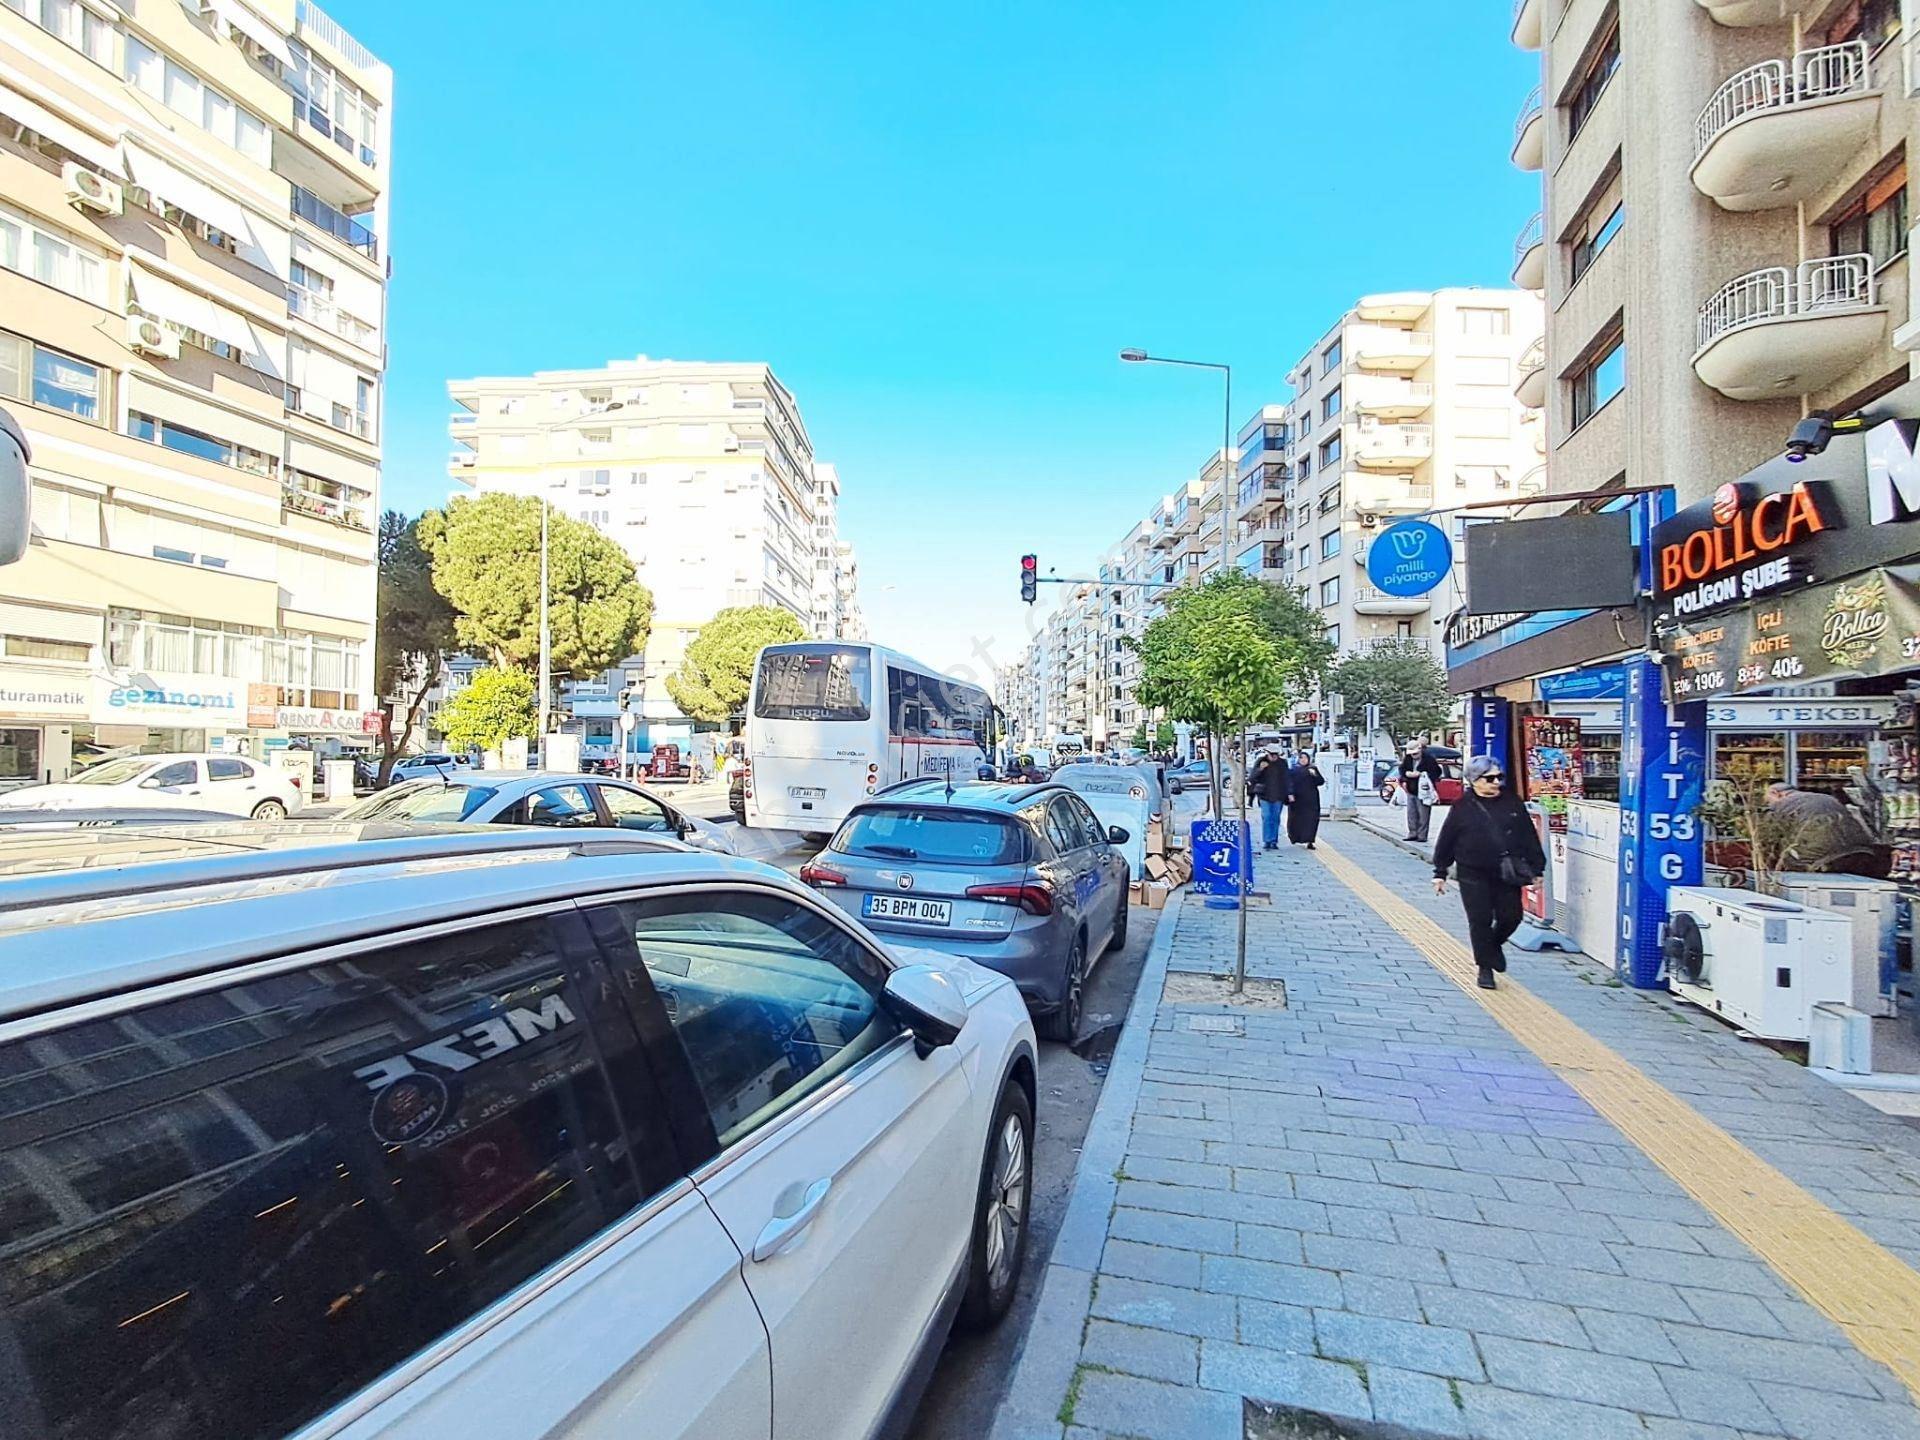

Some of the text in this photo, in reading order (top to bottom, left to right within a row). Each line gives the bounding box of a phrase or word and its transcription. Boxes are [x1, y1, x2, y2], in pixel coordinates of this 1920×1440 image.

[1662, 481, 1824, 592] BOLLCA
[1396, 559, 1424, 573] milli
[1383, 571, 1437, 586] piyango
[1673, 555, 1792, 616] POLİGON ŞUBE
[1821, 609, 1889, 650] Bollca
[1749, 633, 1791, 655] KÖFTE
[1682, 651, 1716, 669] KÖFTE
[1771, 656, 1804, 678] 40₺
[1694, 671, 1725, 691] 190₺
[0, 688, 85, 704] turamatik
[109, 687, 235, 707] gezinomi
[791, 708, 831, 719] ISUZU
[1768, 707, 1881, 721] TEKEL
[1650, 813, 1694, 840] 53
[1210, 847, 1231, 867] +1
[872, 898, 946, 919] 35 BPM 004
